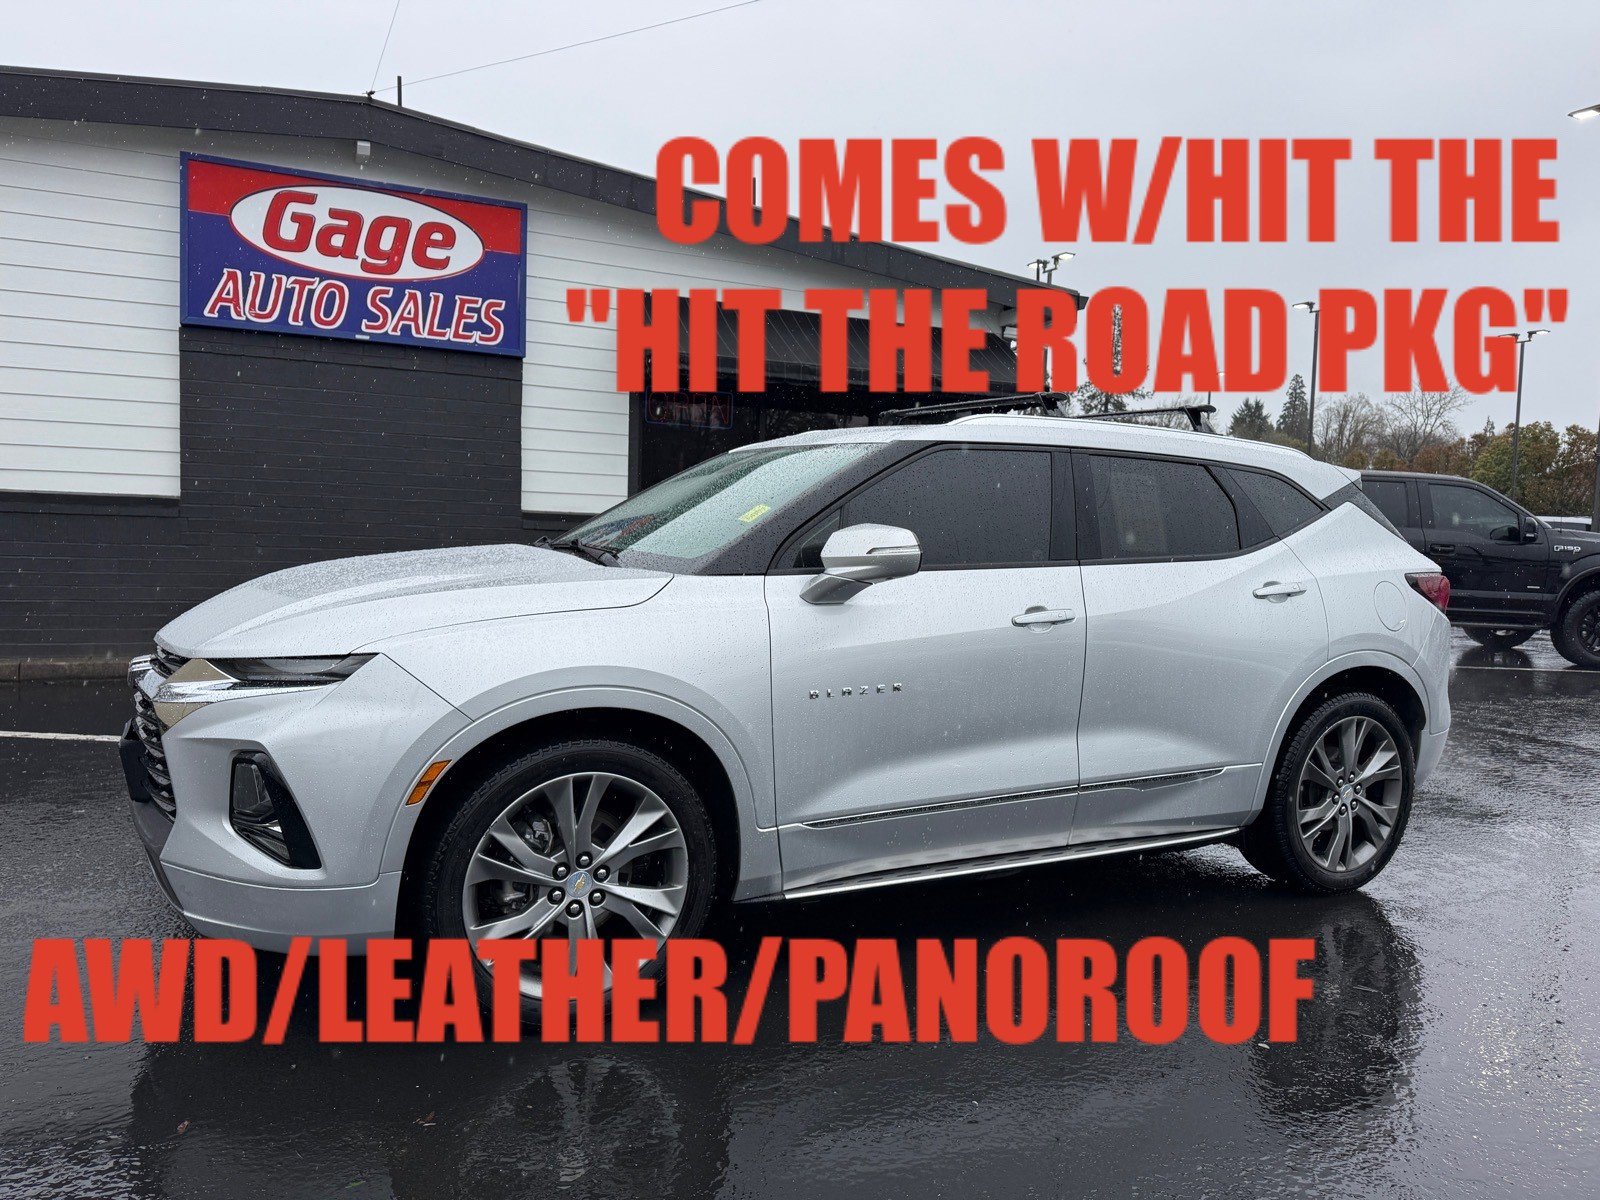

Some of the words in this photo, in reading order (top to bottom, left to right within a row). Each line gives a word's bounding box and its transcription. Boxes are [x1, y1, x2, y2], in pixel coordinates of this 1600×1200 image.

[262, 189, 456, 275] Gage
[203, 267, 350, 329] AUTO
[361, 286, 506, 345] SALES
[808, 682, 903, 700] BLAZER
